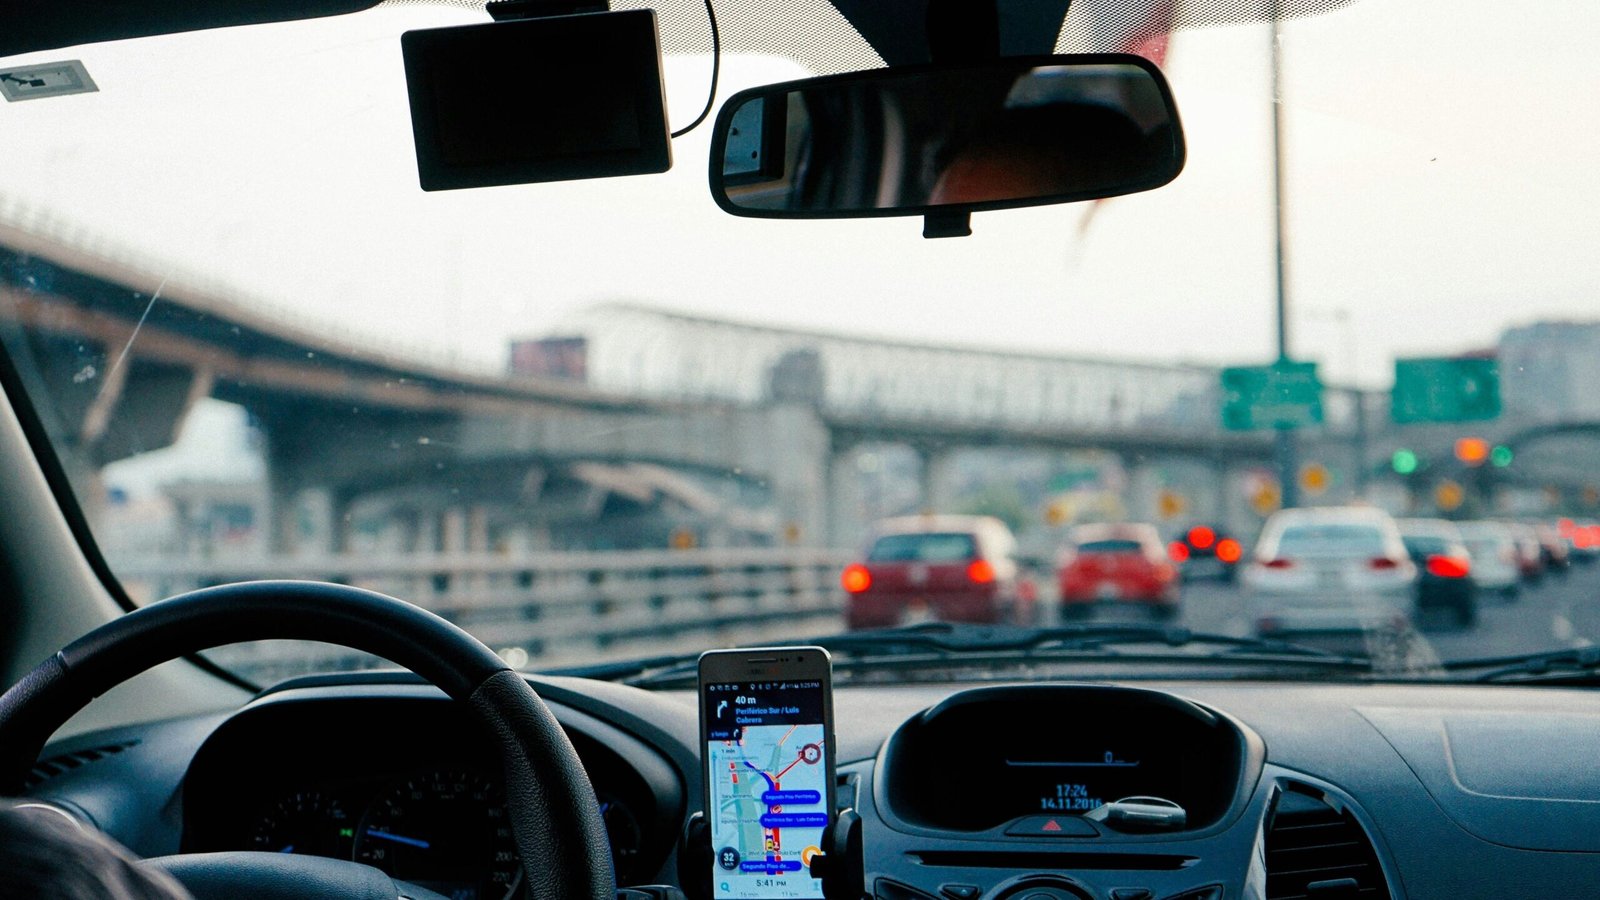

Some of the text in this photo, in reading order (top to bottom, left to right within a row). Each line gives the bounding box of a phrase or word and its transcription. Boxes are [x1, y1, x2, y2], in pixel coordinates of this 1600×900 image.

[735, 695, 757, 705] 40 m
[1105, 750, 1113, 763] 0
[1056, 784, 1088, 797] 17:24
[1041, 798, 1102, 809] 14.11.2016
[723, 852, 735, 862] 32
[756, 879, 774, 887] 5:41
